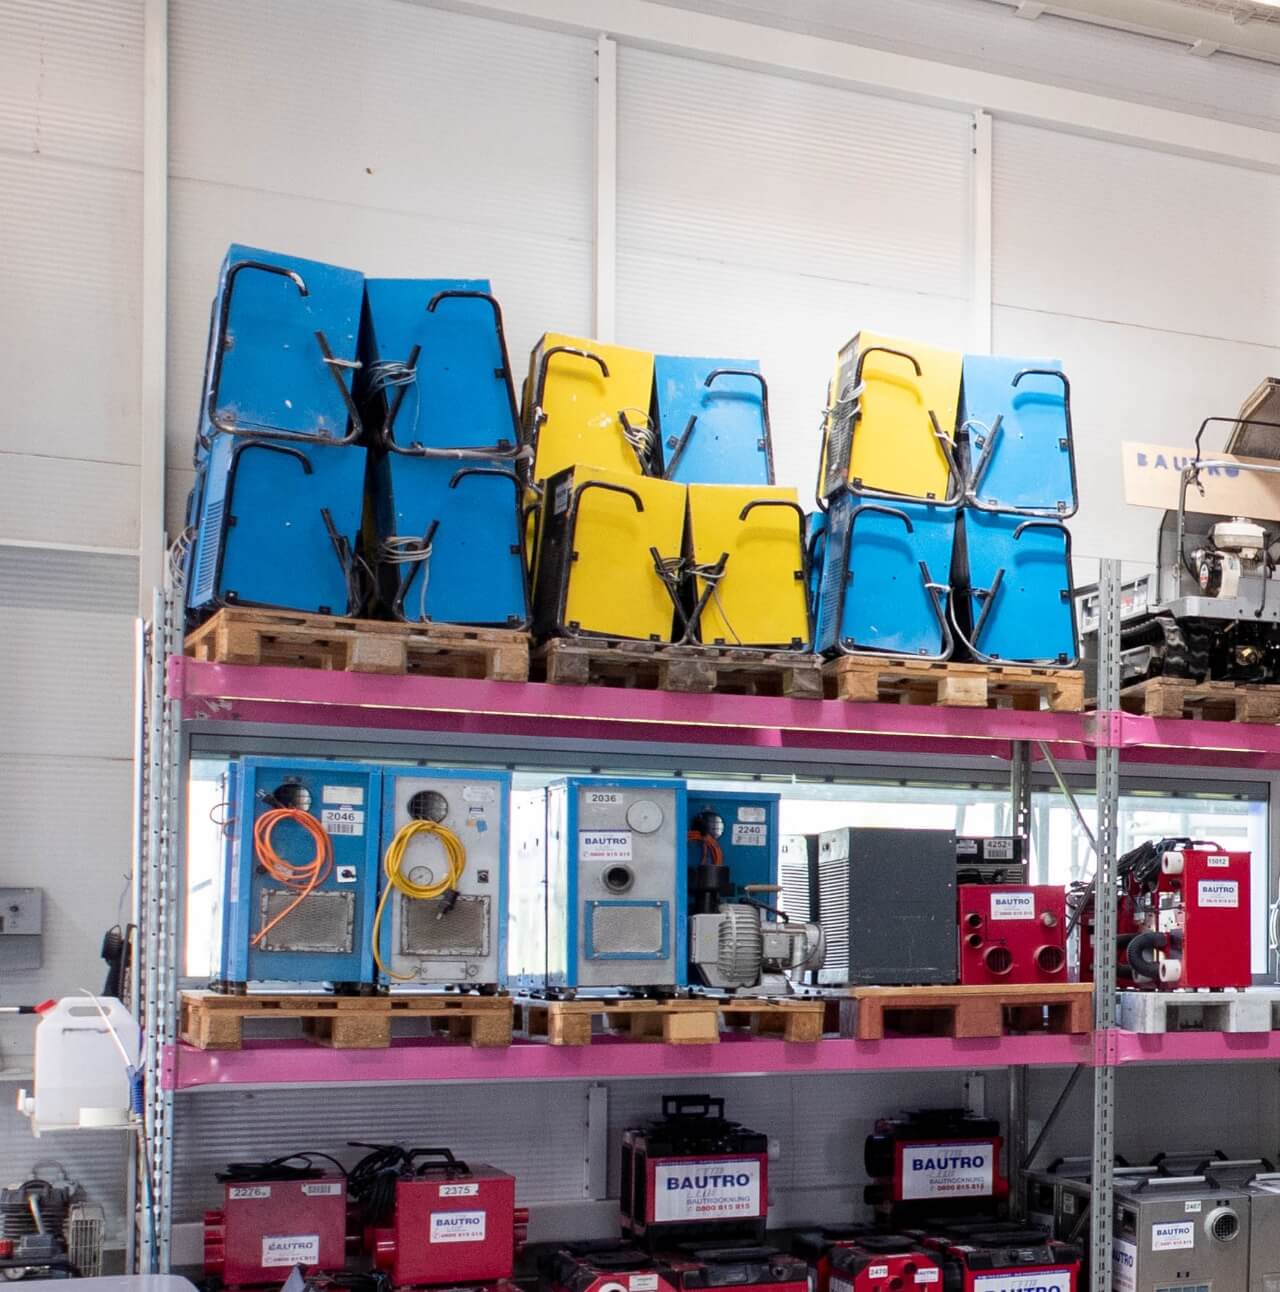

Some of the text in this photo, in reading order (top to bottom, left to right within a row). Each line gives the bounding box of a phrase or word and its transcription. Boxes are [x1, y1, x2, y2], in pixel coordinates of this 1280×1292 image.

[592, 794, 617, 802] 2036
[327, 812, 355, 821] 2046
[912, 1156, 984, 1171] BAUTRO
[667, 1173, 750, 1190] BAUTRO
[436, 1218, 480, 1226] BAUTRO
[268, 1242, 312, 1250] BAUTRO
